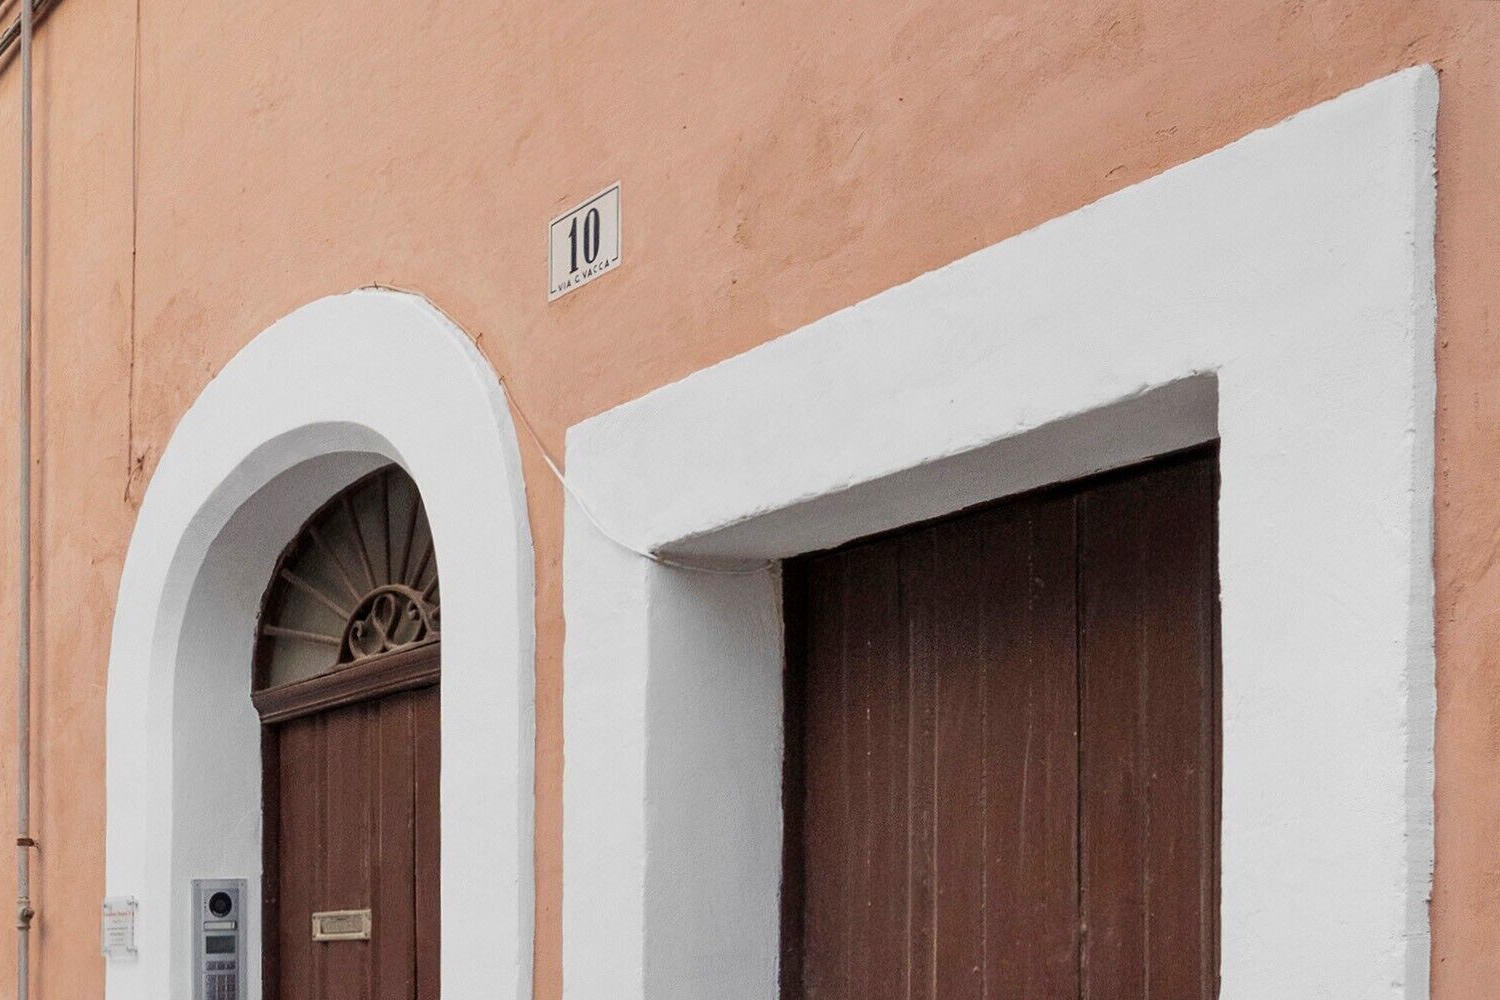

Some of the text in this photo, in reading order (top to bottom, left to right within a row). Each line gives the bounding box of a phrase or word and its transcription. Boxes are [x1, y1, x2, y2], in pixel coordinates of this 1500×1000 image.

[567, 207, 600, 275] 10
[558, 280, 572, 292] VIA
[582, 260, 610, 279] VACCA
